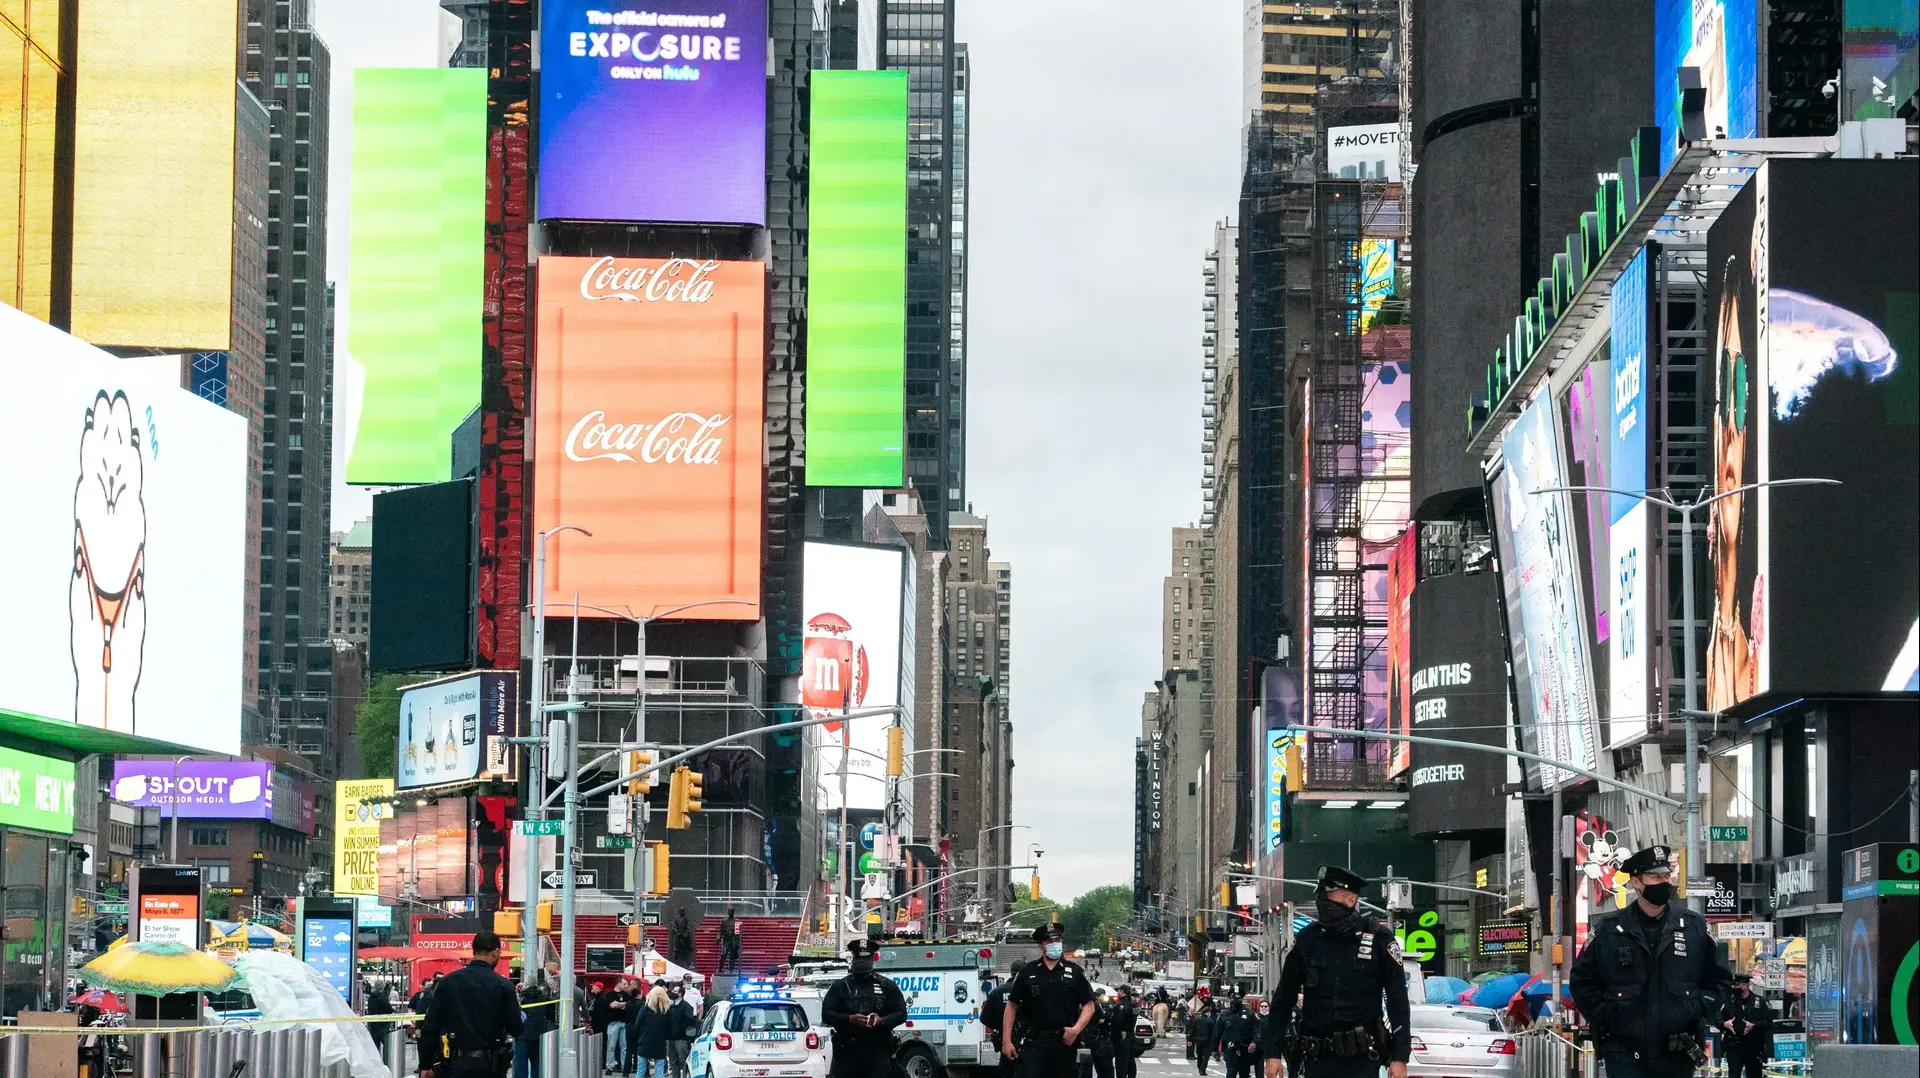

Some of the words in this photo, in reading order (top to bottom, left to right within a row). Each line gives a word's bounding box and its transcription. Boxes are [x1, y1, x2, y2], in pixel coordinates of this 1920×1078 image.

[586, 10, 612, 24] The
[613, 10, 657, 26] official
[658, 14, 710, 27] camera
[710, 13, 726, 28] of
[570, 32, 740, 62] EXPOSURE
[610, 66, 643, 80] ONLY
[643, 66, 662, 80] ON
[663, 64, 700, 80] hulu
[1525, 128, 1641, 359] BROADWAY
[580, 256, 721, 302] Coca-Cola
[564, 410, 732, 464] Coca-Cola
[1620, 547, 1636, 606] SHOP
[1620, 606, 1636, 660] NOW
[816, 656, 840, 692] m
[1439, 662, 1471, 686] THIS
[498, 680, 506, 692] Air
[149, 776, 228, 794] SHOUT
[1152, 733, 1162, 829] WELLINGTON
[35, 774, 62, 812] NEW
[345, 786, 360, 798] EARN
[360, 785, 384, 797] BADGES
[526, 823, 534, 834] W
[539, 822, 551, 833] 45
[1712, 829, 1720, 839] W
[1725, 828, 1735, 839] 45
[344, 837, 355, 849] WIN
[356, 837, 379, 849] SUMME
[605, 837, 612, 846] W
[616, 837, 624, 846] 45
[351, 877, 374, 890] ONLINE
[1707, 899, 1736, 907] ASSN.
[308, 937, 327, 947] 52°
[1483, 927, 1525, 941] ELECTRONICS
[1505, 941, 1527, 950] LUGGAGE
[892, 977, 939, 991] POLICE
